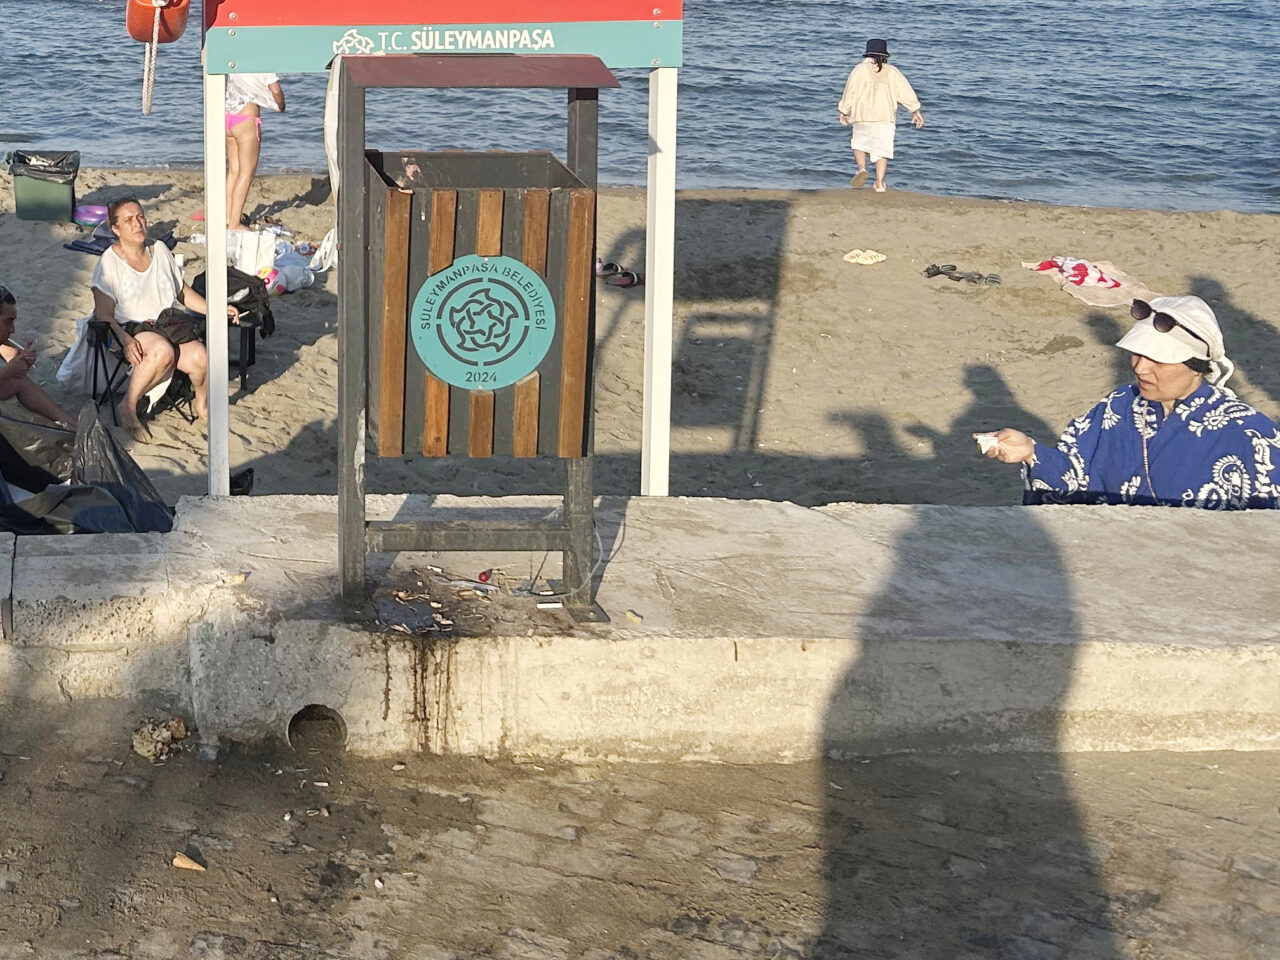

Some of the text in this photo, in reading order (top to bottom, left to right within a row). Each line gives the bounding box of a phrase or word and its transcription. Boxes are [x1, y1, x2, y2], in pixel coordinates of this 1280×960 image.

[378, 27, 555, 51] T.C. SÜLEYMANPAŞA
[465, 371, 497, 383] 2024
